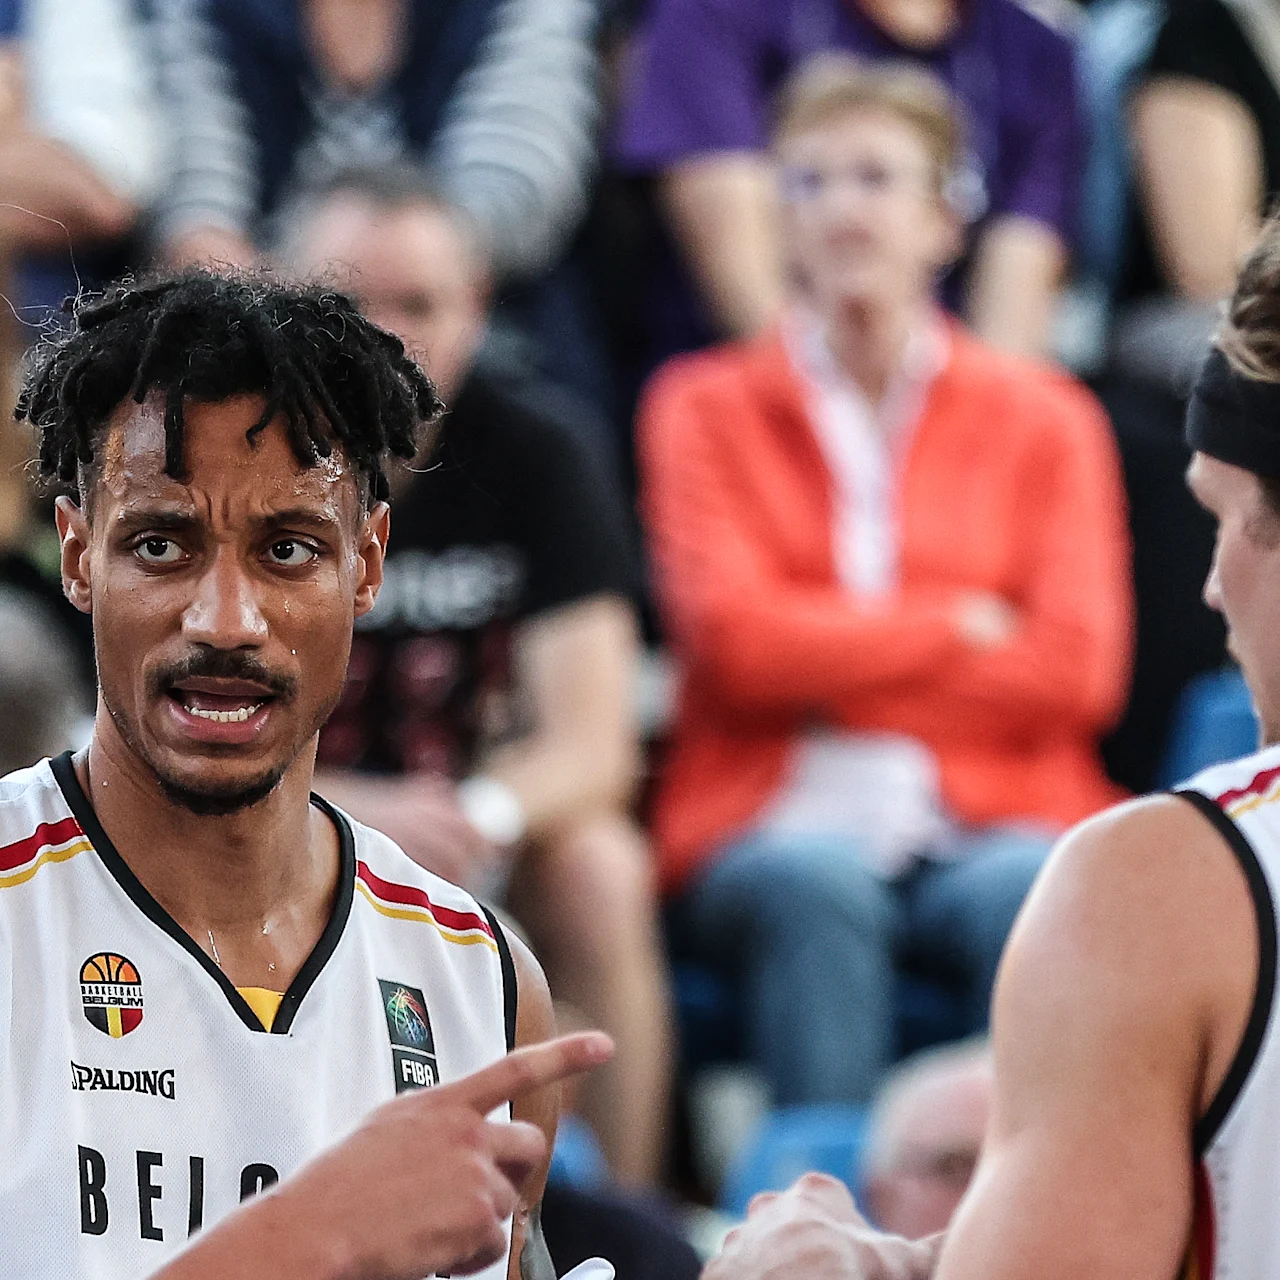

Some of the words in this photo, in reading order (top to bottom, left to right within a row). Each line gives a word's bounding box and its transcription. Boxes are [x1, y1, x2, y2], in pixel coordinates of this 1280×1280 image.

[81, 985, 144, 997] BASKETBALL
[81, 995, 144, 1007] BELGIUM
[401, 1058, 435, 1088] FIBA
